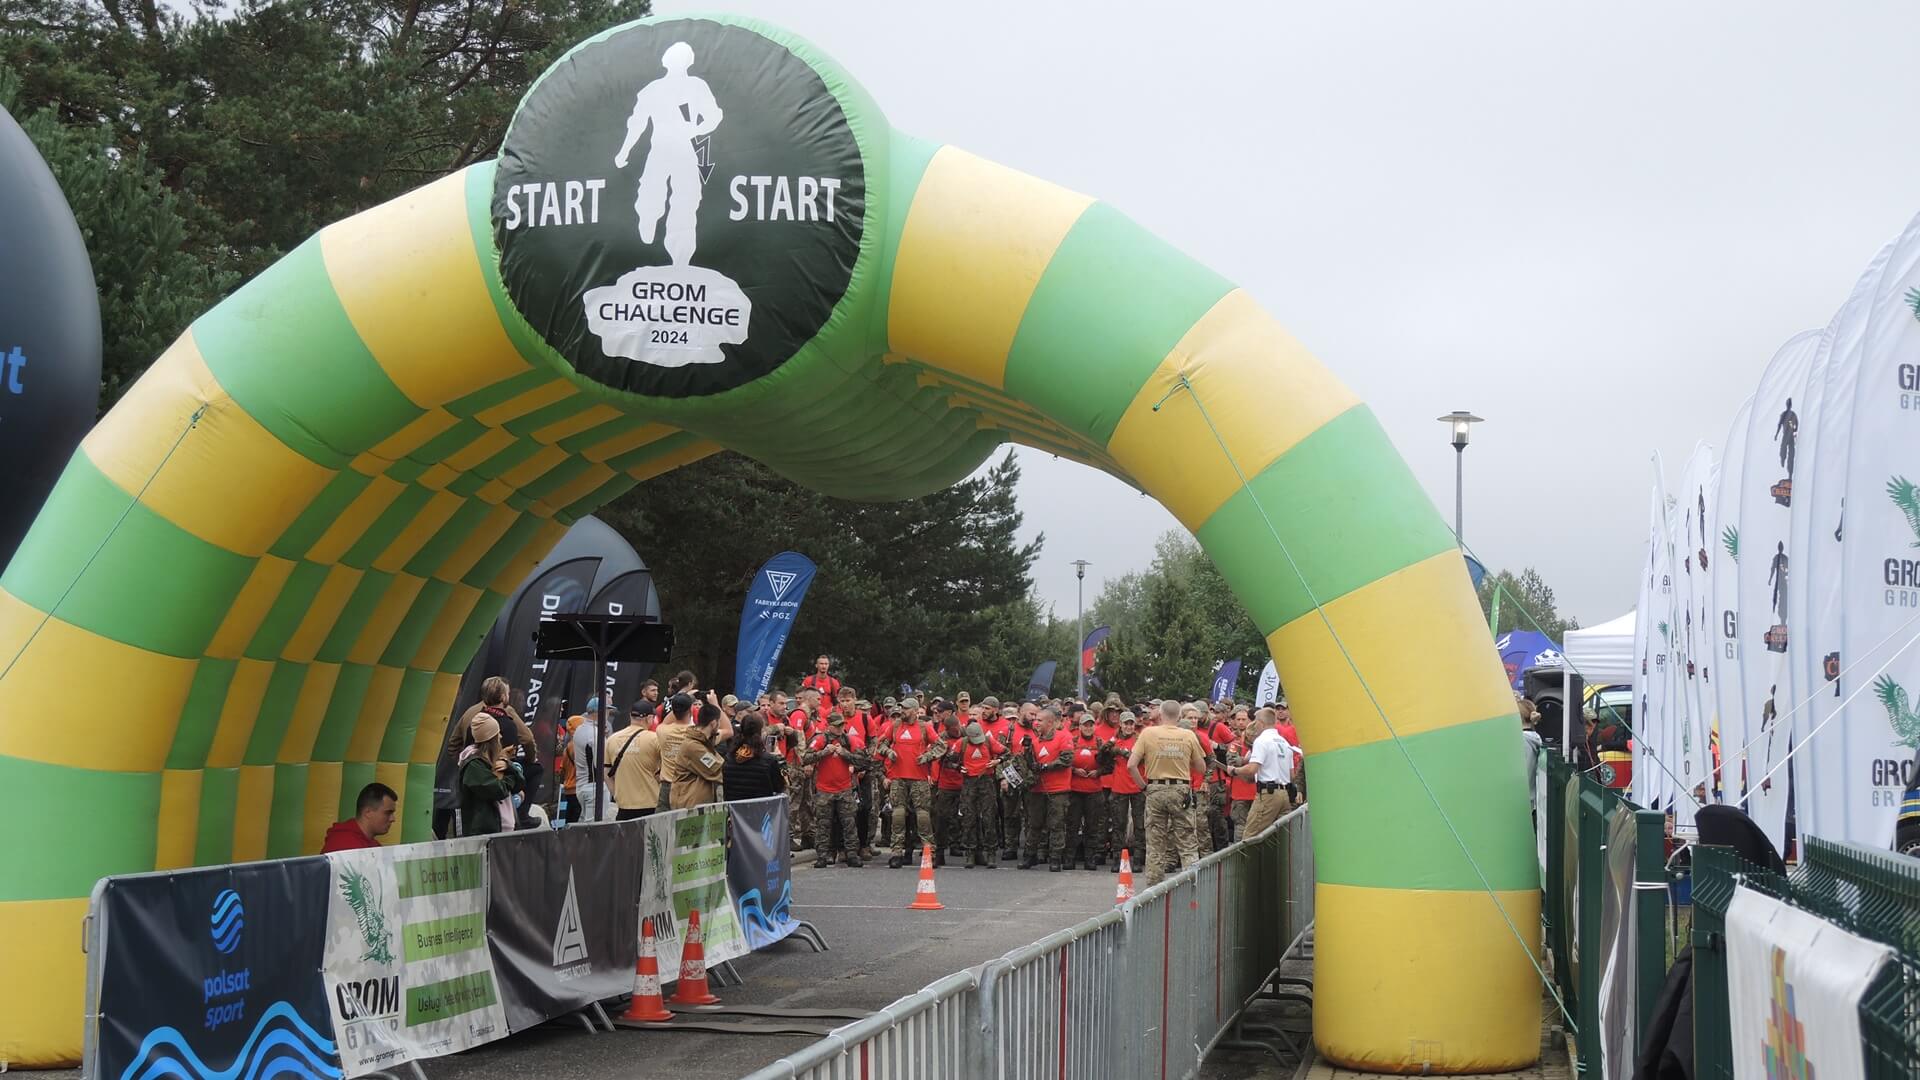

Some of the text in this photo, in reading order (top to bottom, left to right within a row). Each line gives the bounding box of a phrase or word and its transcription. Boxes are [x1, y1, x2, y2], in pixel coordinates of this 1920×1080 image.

[506, 175, 841, 231] START START
[632, 281, 706, 302] GROM
[599, 303, 740, 326] CHALLENGE
[651, 330, 689, 344] 2024
[772, 611, 791, 620] PGZ
[204, 968, 250, 1004] polsat
[204, 998, 245, 1031] sport
